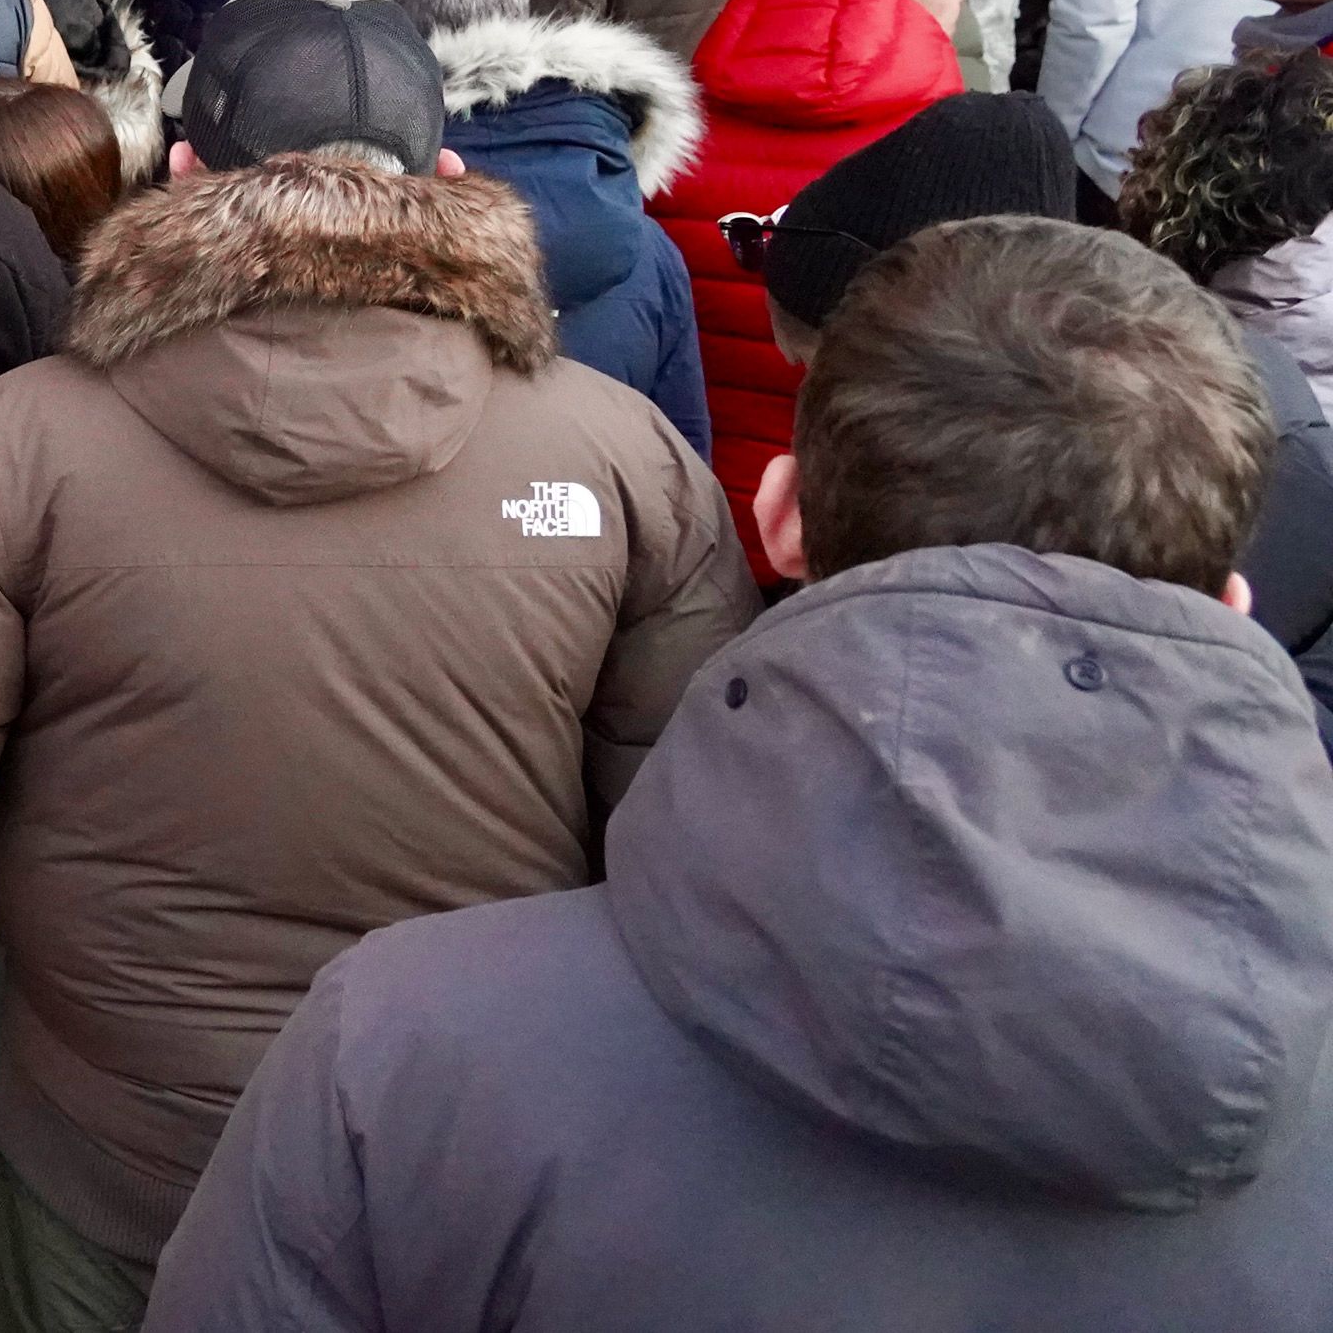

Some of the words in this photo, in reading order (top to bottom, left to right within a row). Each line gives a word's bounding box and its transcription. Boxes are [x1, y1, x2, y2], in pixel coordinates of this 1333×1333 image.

[530, 482, 568, 500] THE
[502, 499, 568, 519] NORTH
[522, 518, 569, 537] FACE
